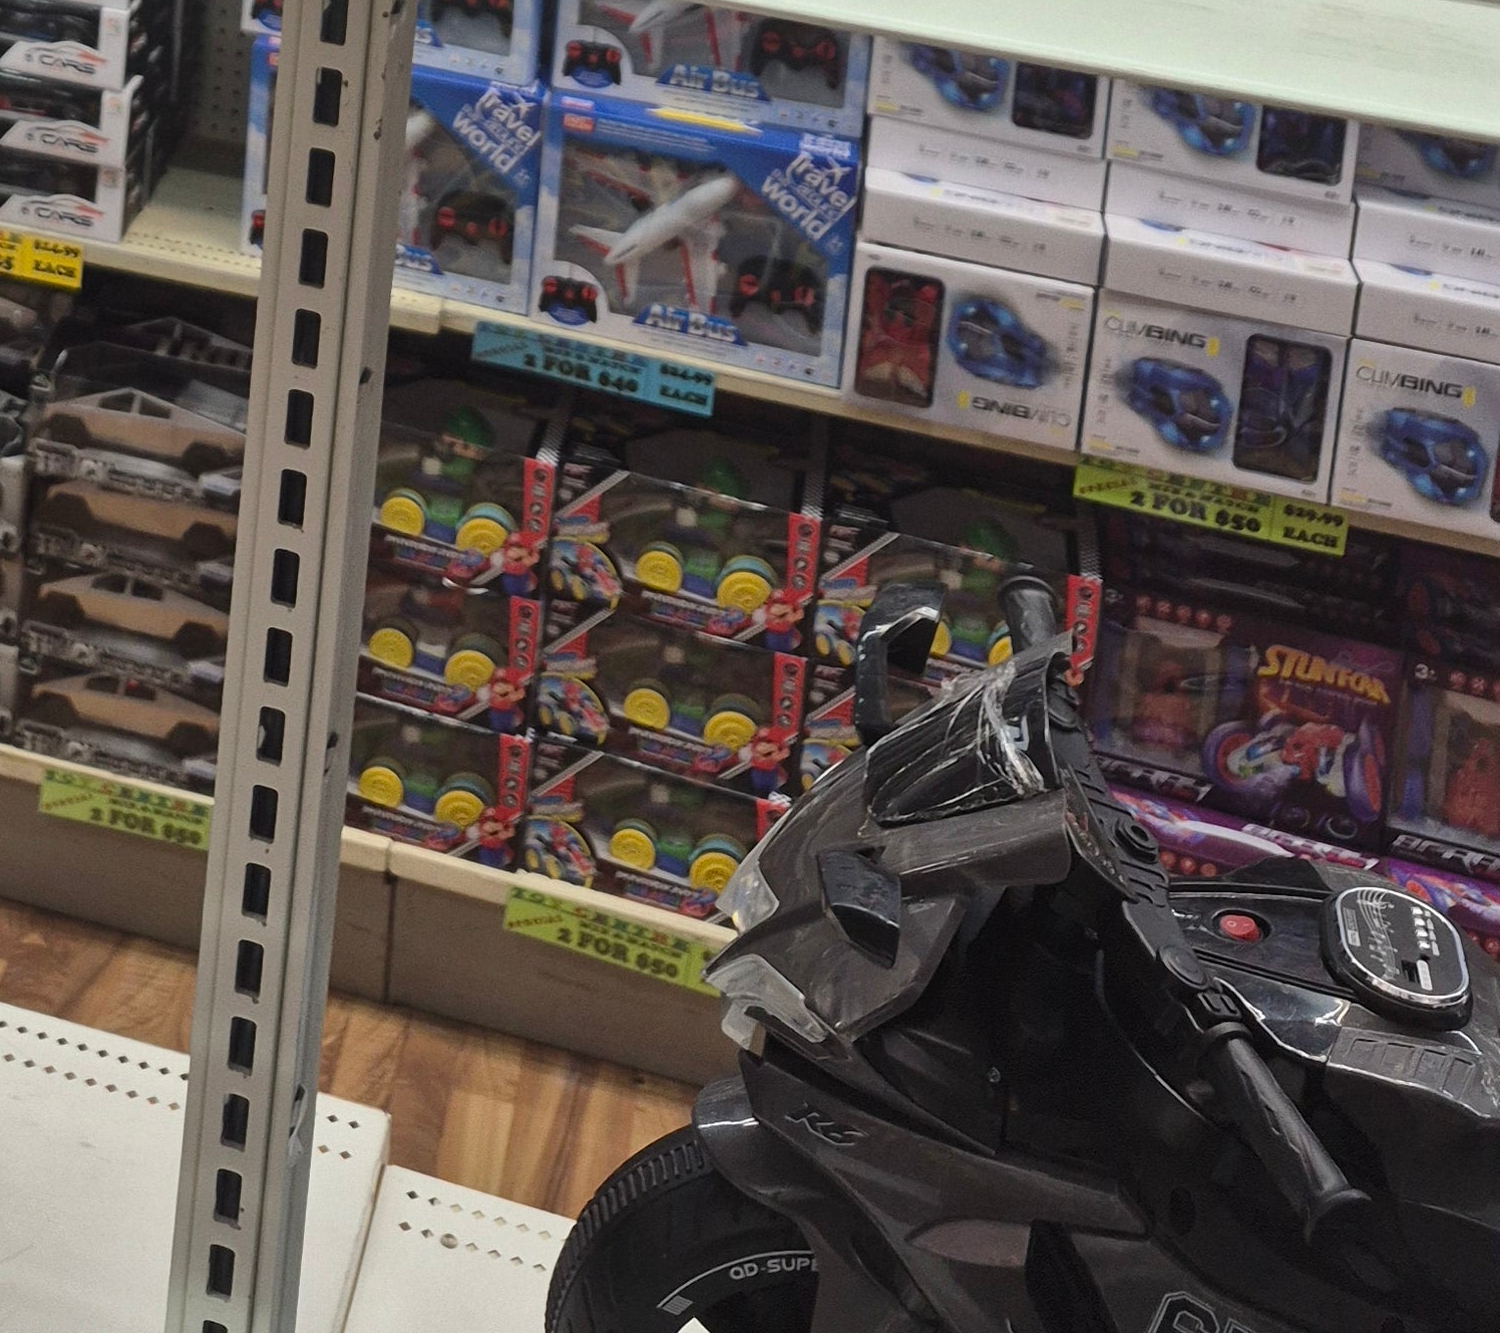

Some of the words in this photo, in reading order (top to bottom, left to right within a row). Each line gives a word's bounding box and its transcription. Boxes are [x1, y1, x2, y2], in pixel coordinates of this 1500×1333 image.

[38, 53, 97, 76] CARS
[39, 132, 99, 154] CARS
[35, 206, 94, 229] CARS
[760, 175, 835, 241] world
[542, 354, 591, 382] FOR
[1130, 490, 1146, 508] 2
[1151, 492, 1209, 522] FOR
[1214, 507, 1262, 534] $50
[1282, 525, 1339, 549] EACH
[109, 808, 156, 835] FOR
[556, 926, 573, 945] 2
[577, 930, 631, 963] FOR
